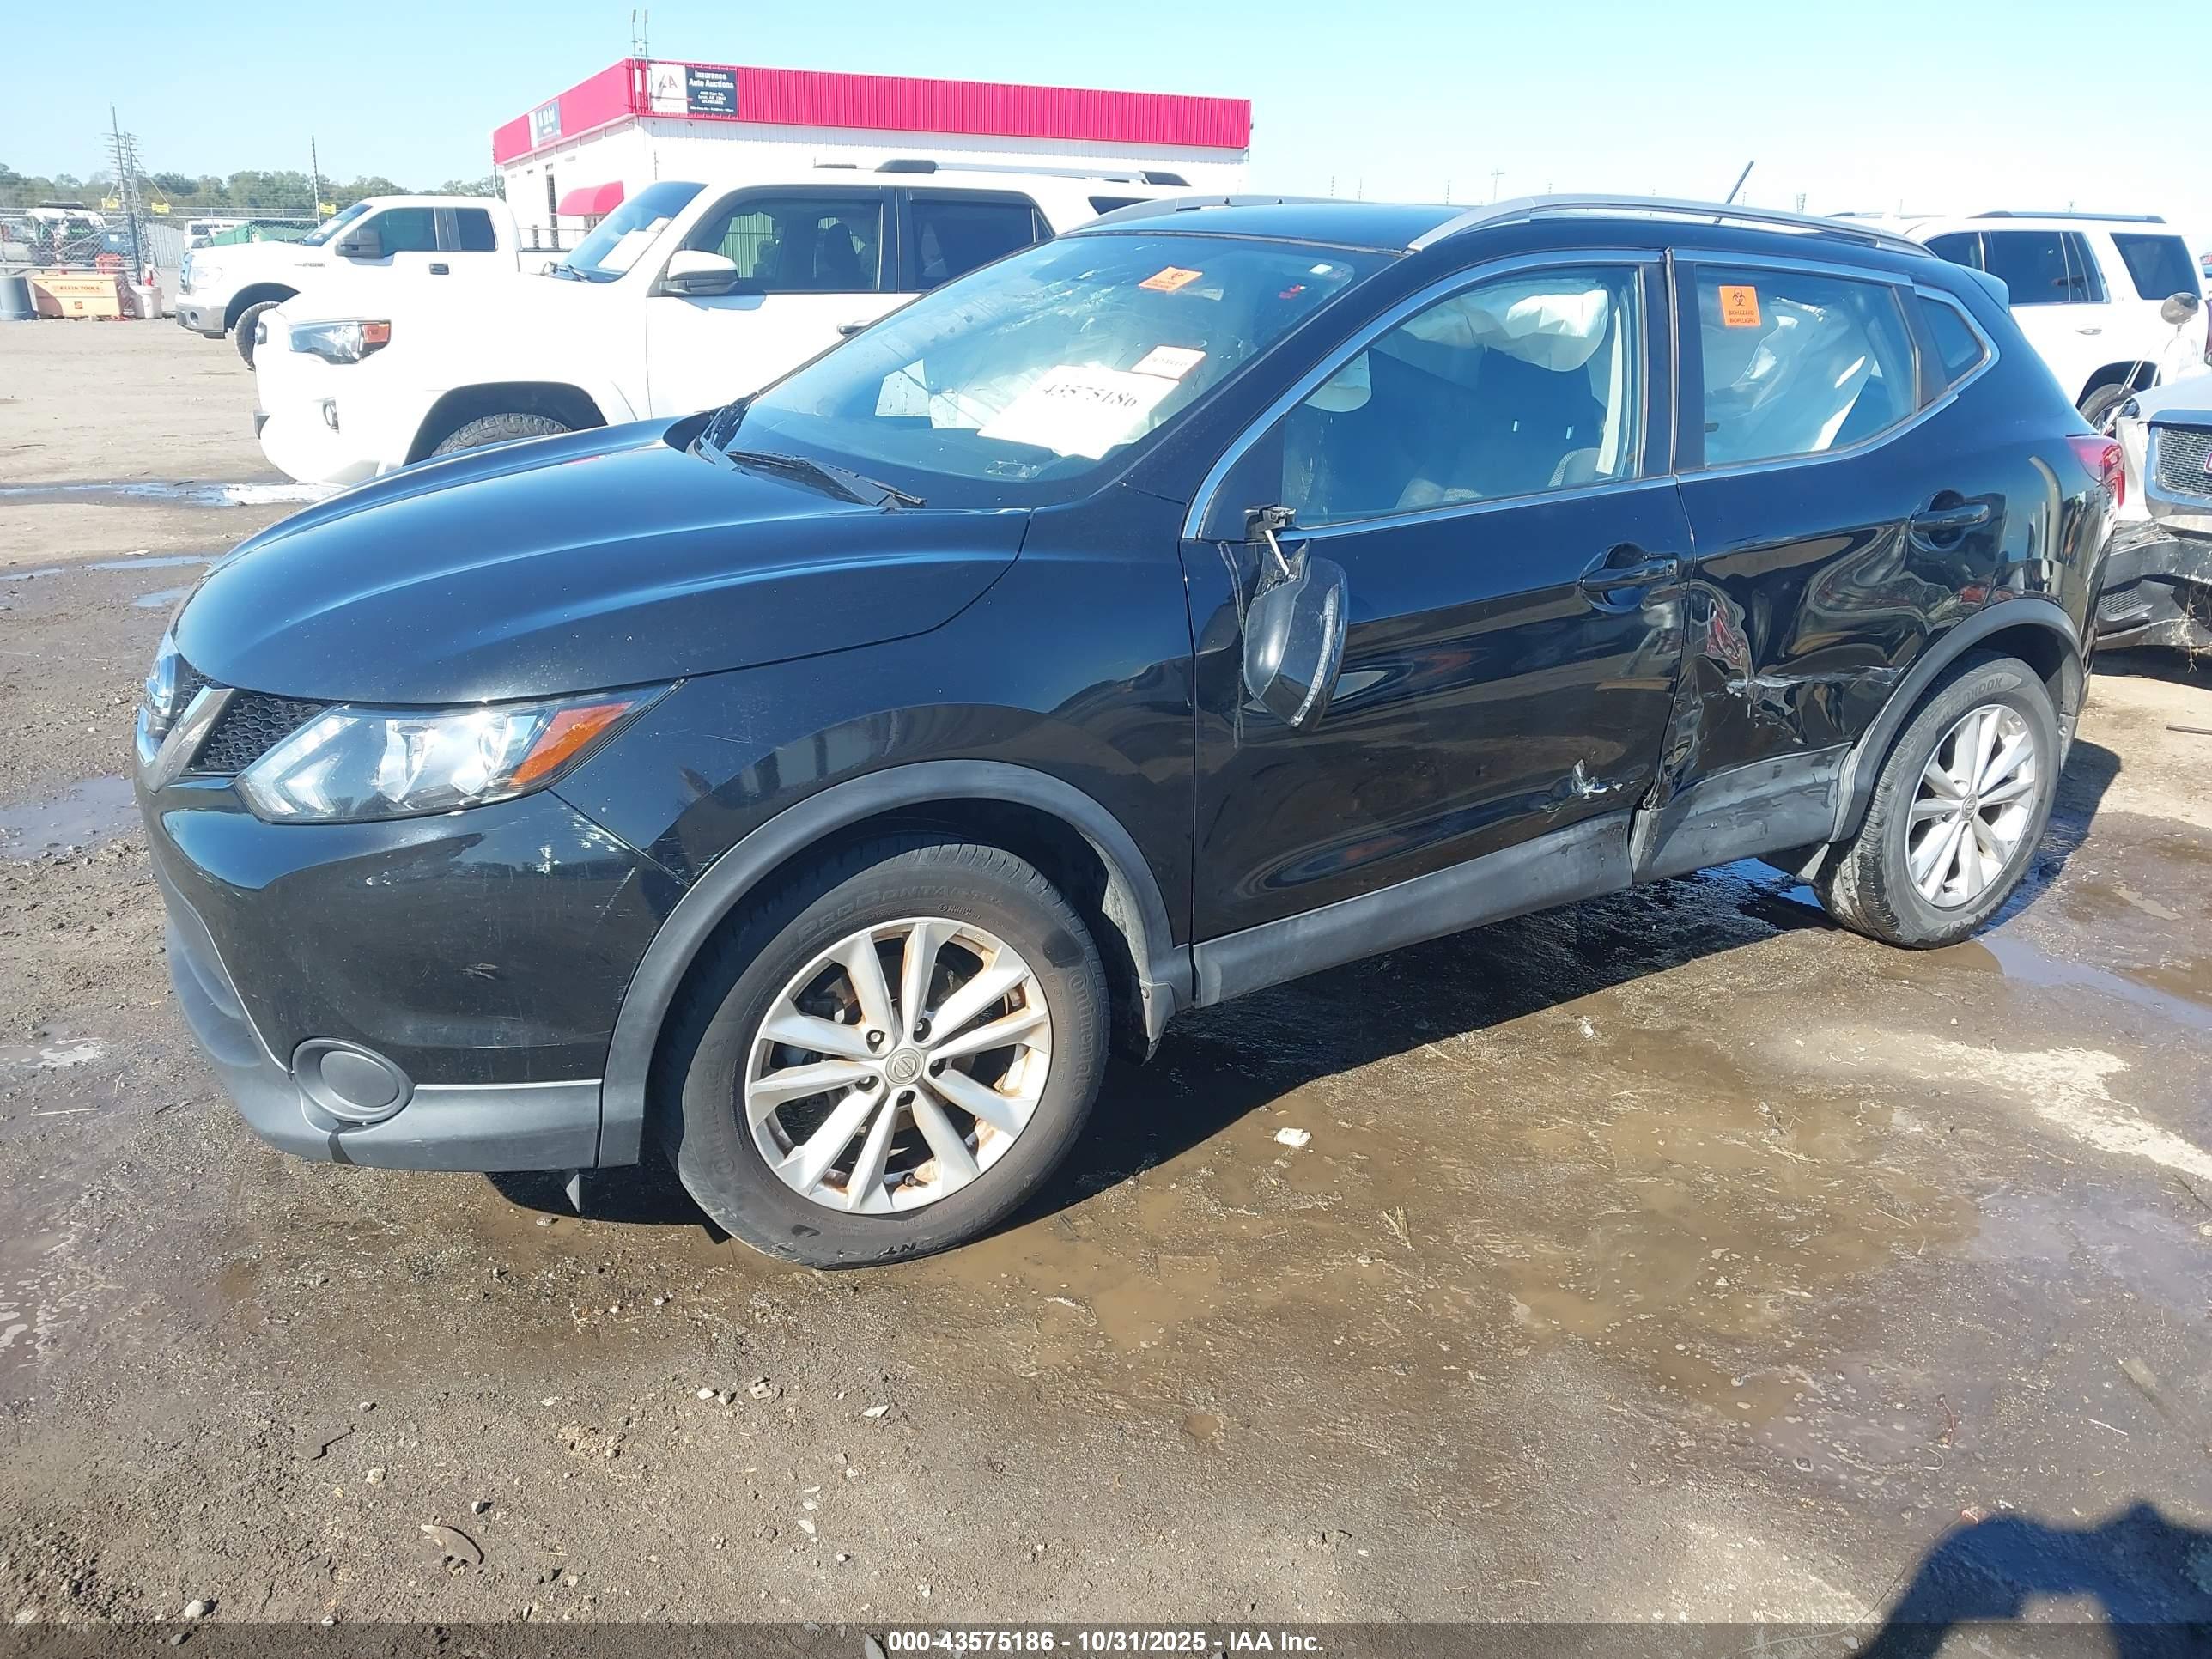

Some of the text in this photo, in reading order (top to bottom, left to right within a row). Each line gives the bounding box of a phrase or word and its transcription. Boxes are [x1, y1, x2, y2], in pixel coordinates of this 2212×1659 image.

[695, 70, 727, 81] Insurance
[689, 78, 734, 89] Auto Auctions
